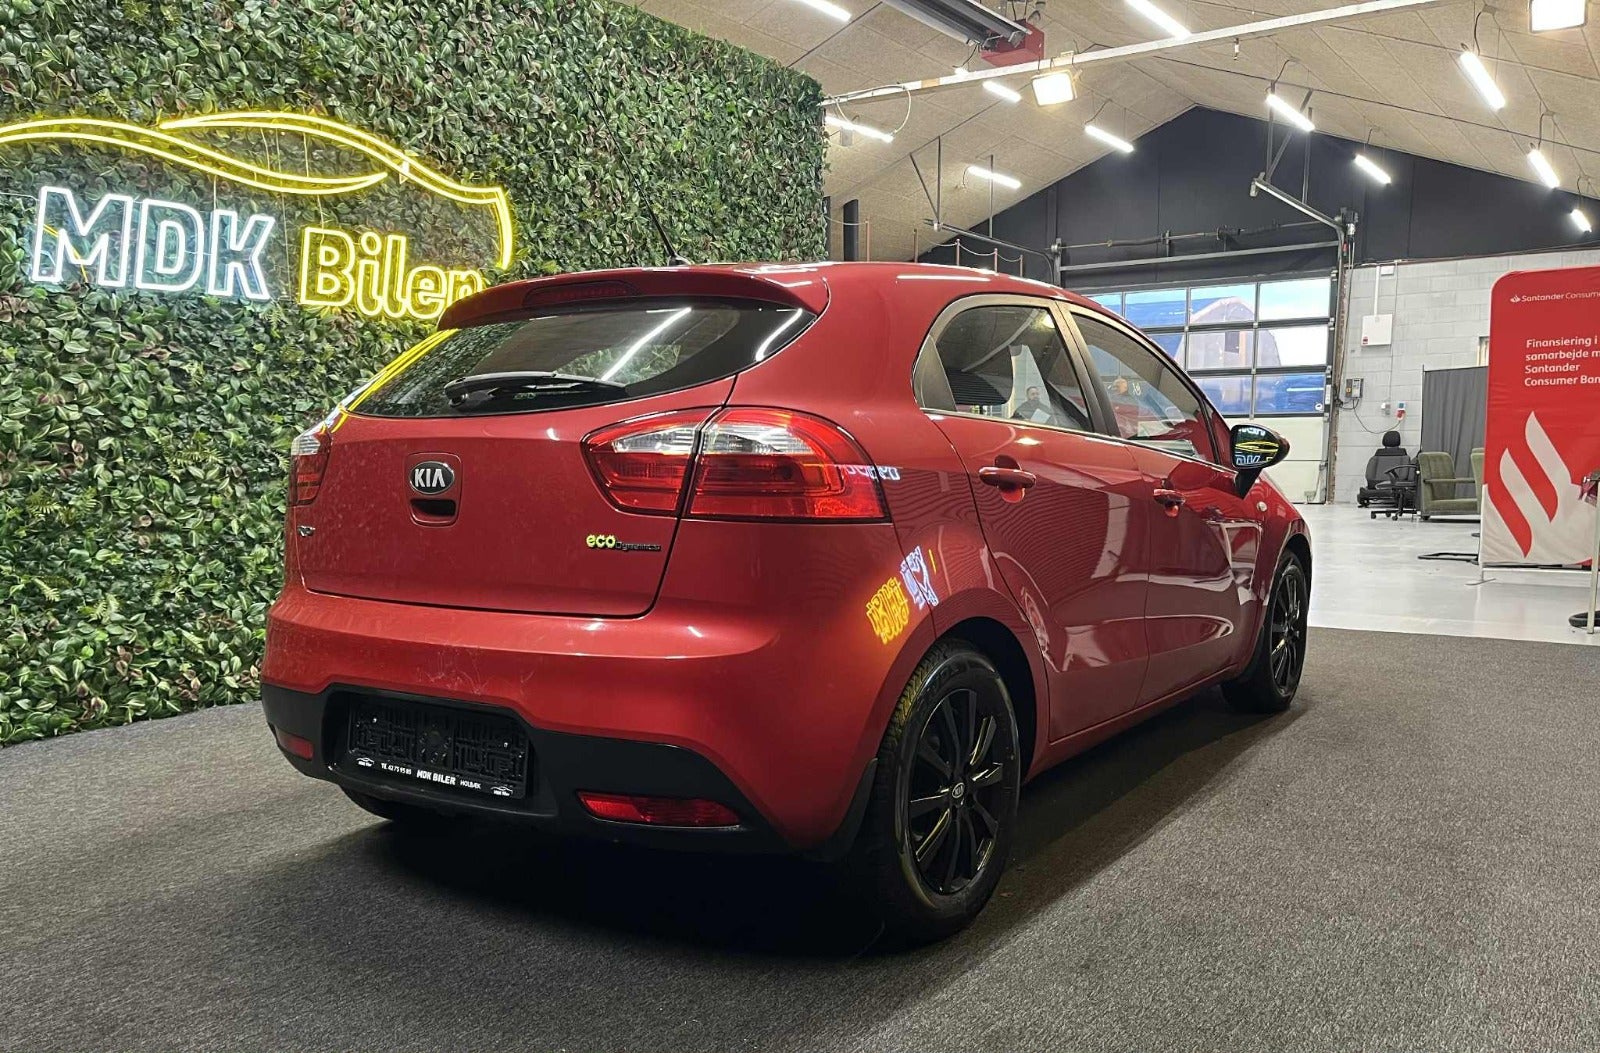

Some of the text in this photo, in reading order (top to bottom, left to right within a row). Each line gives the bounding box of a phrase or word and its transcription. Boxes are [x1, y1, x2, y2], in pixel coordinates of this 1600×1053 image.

[31, 186, 275, 301] MDK
[1521, 294, 1564, 302] Santander
[1526, 334, 1598, 348] Finansiering i
[1525, 348, 1589, 361] samarbejde
[1525, 362, 1580, 374] Santander
[1524, 377, 1579, 387] Consumer
[414, 468, 446, 488] KIA
[416, 769, 432, 780] MDK
[432, 772, 456, 786] BILER
